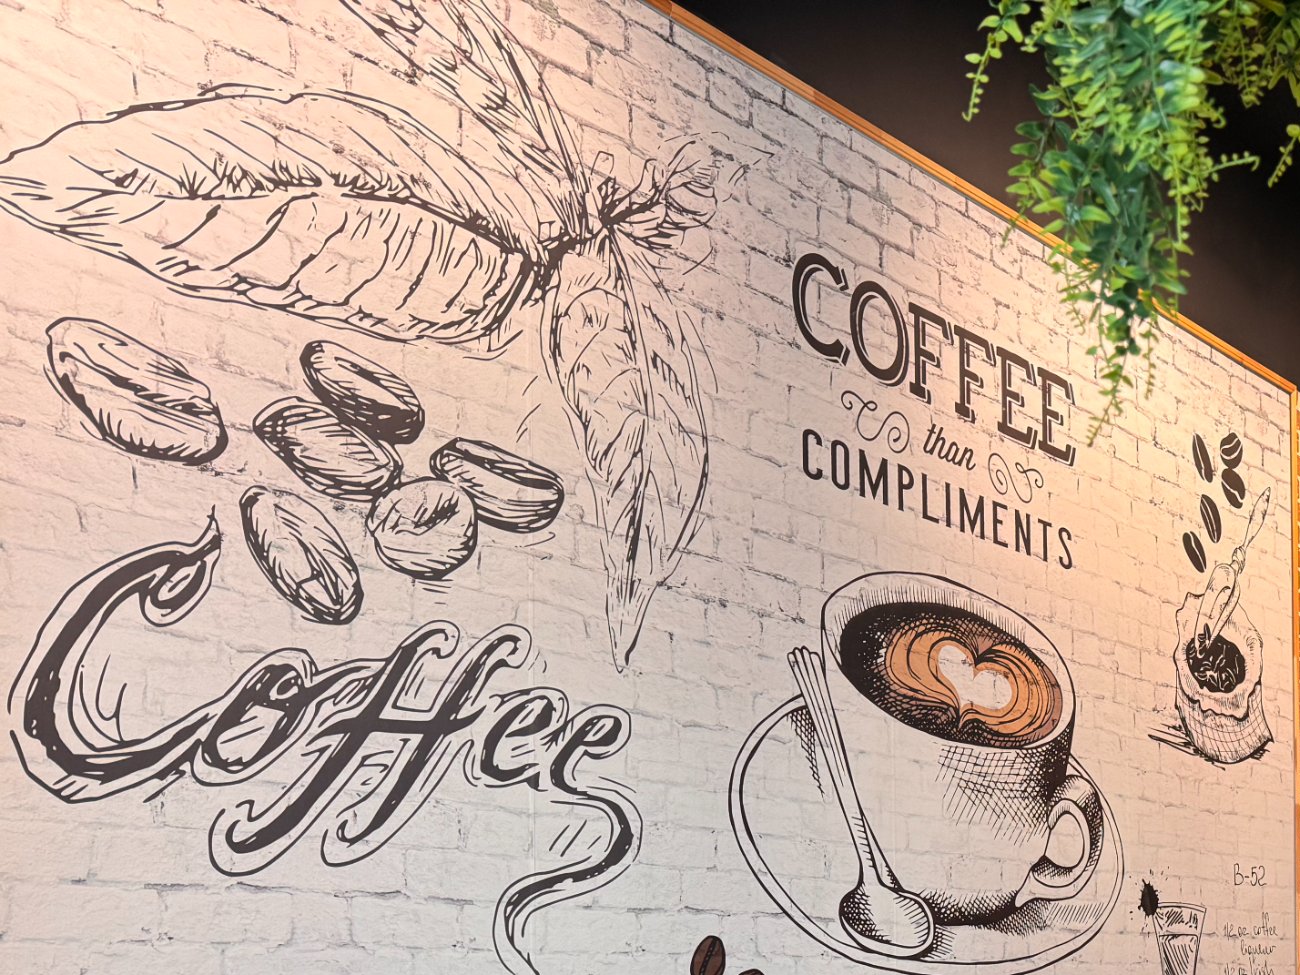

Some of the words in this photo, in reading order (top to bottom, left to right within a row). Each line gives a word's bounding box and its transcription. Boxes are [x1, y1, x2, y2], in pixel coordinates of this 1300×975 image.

[792, 252, 1077, 467] COFFEE
[923, 422, 976, 471] than
[802, 428, 1074, 570] COMPLIMENTS
[1233, 863, 1267, 886] B-52
[1253, 912, 1278, 936] coffee
